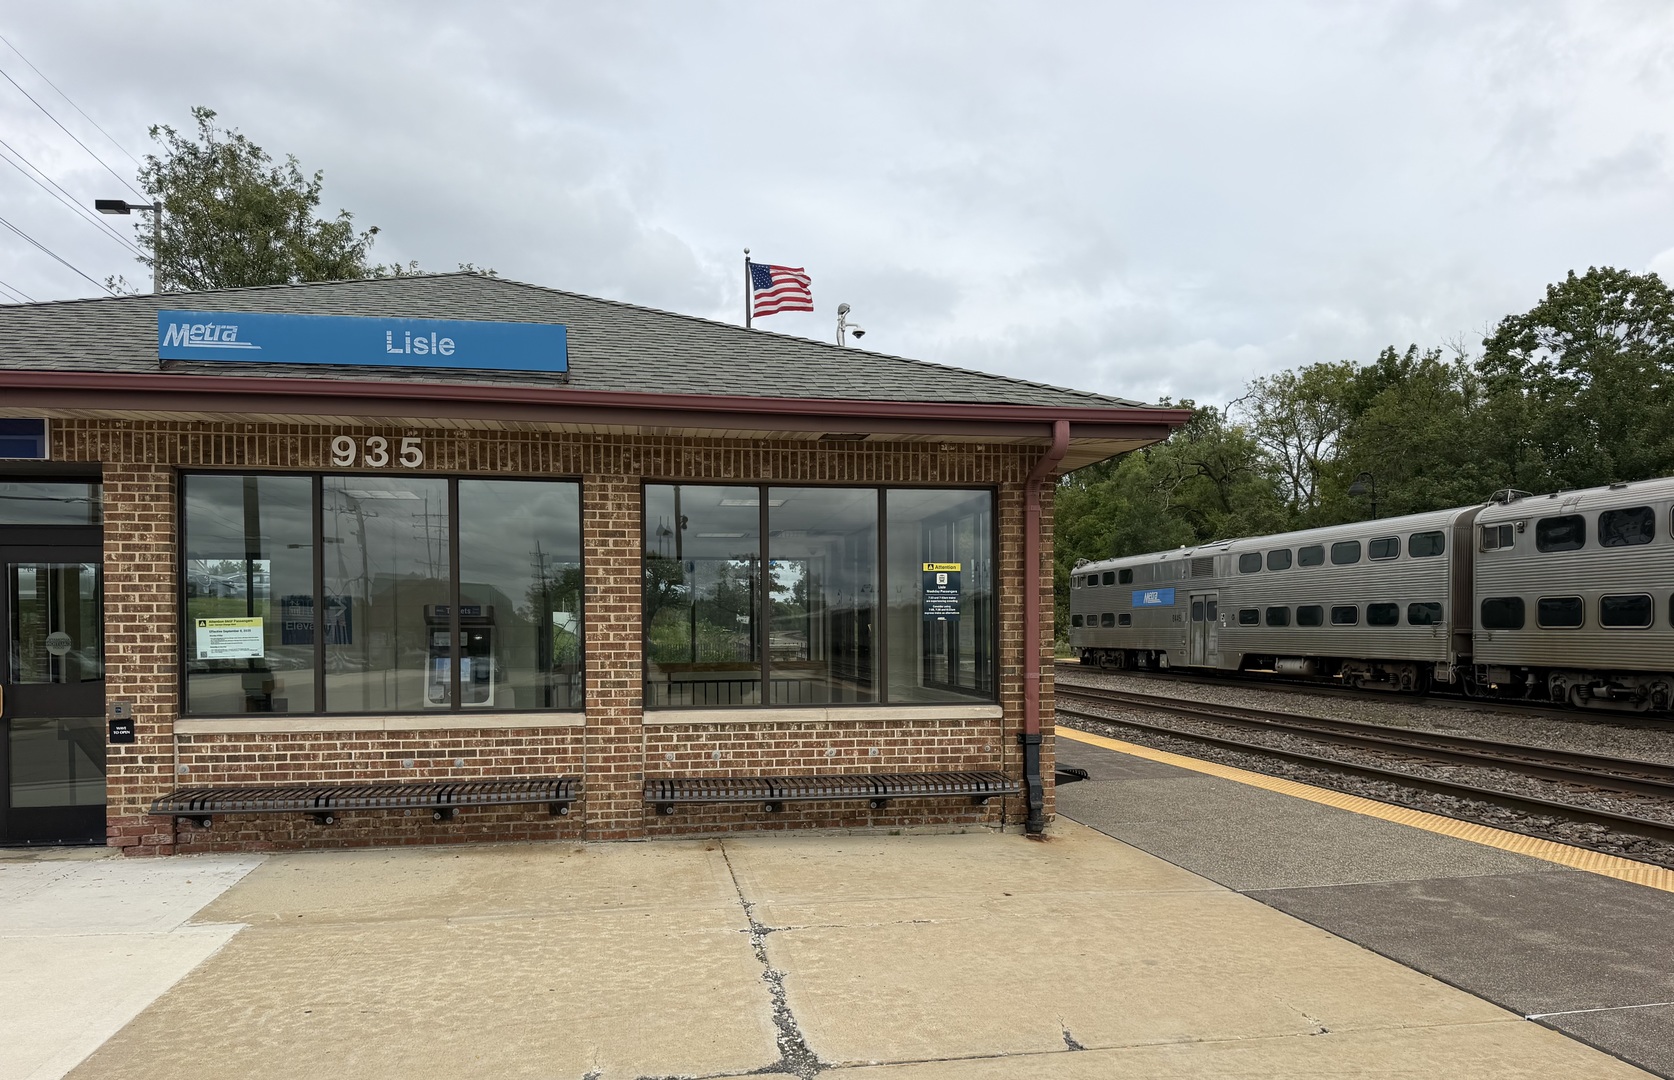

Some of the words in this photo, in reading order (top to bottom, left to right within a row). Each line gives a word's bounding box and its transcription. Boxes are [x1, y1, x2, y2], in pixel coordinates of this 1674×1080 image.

[162, 322, 239, 348] Metra
[386, 330, 456, 356] Lisle
[331, 435, 424, 468] 935
[286, 621, 332, 630] Elevar
